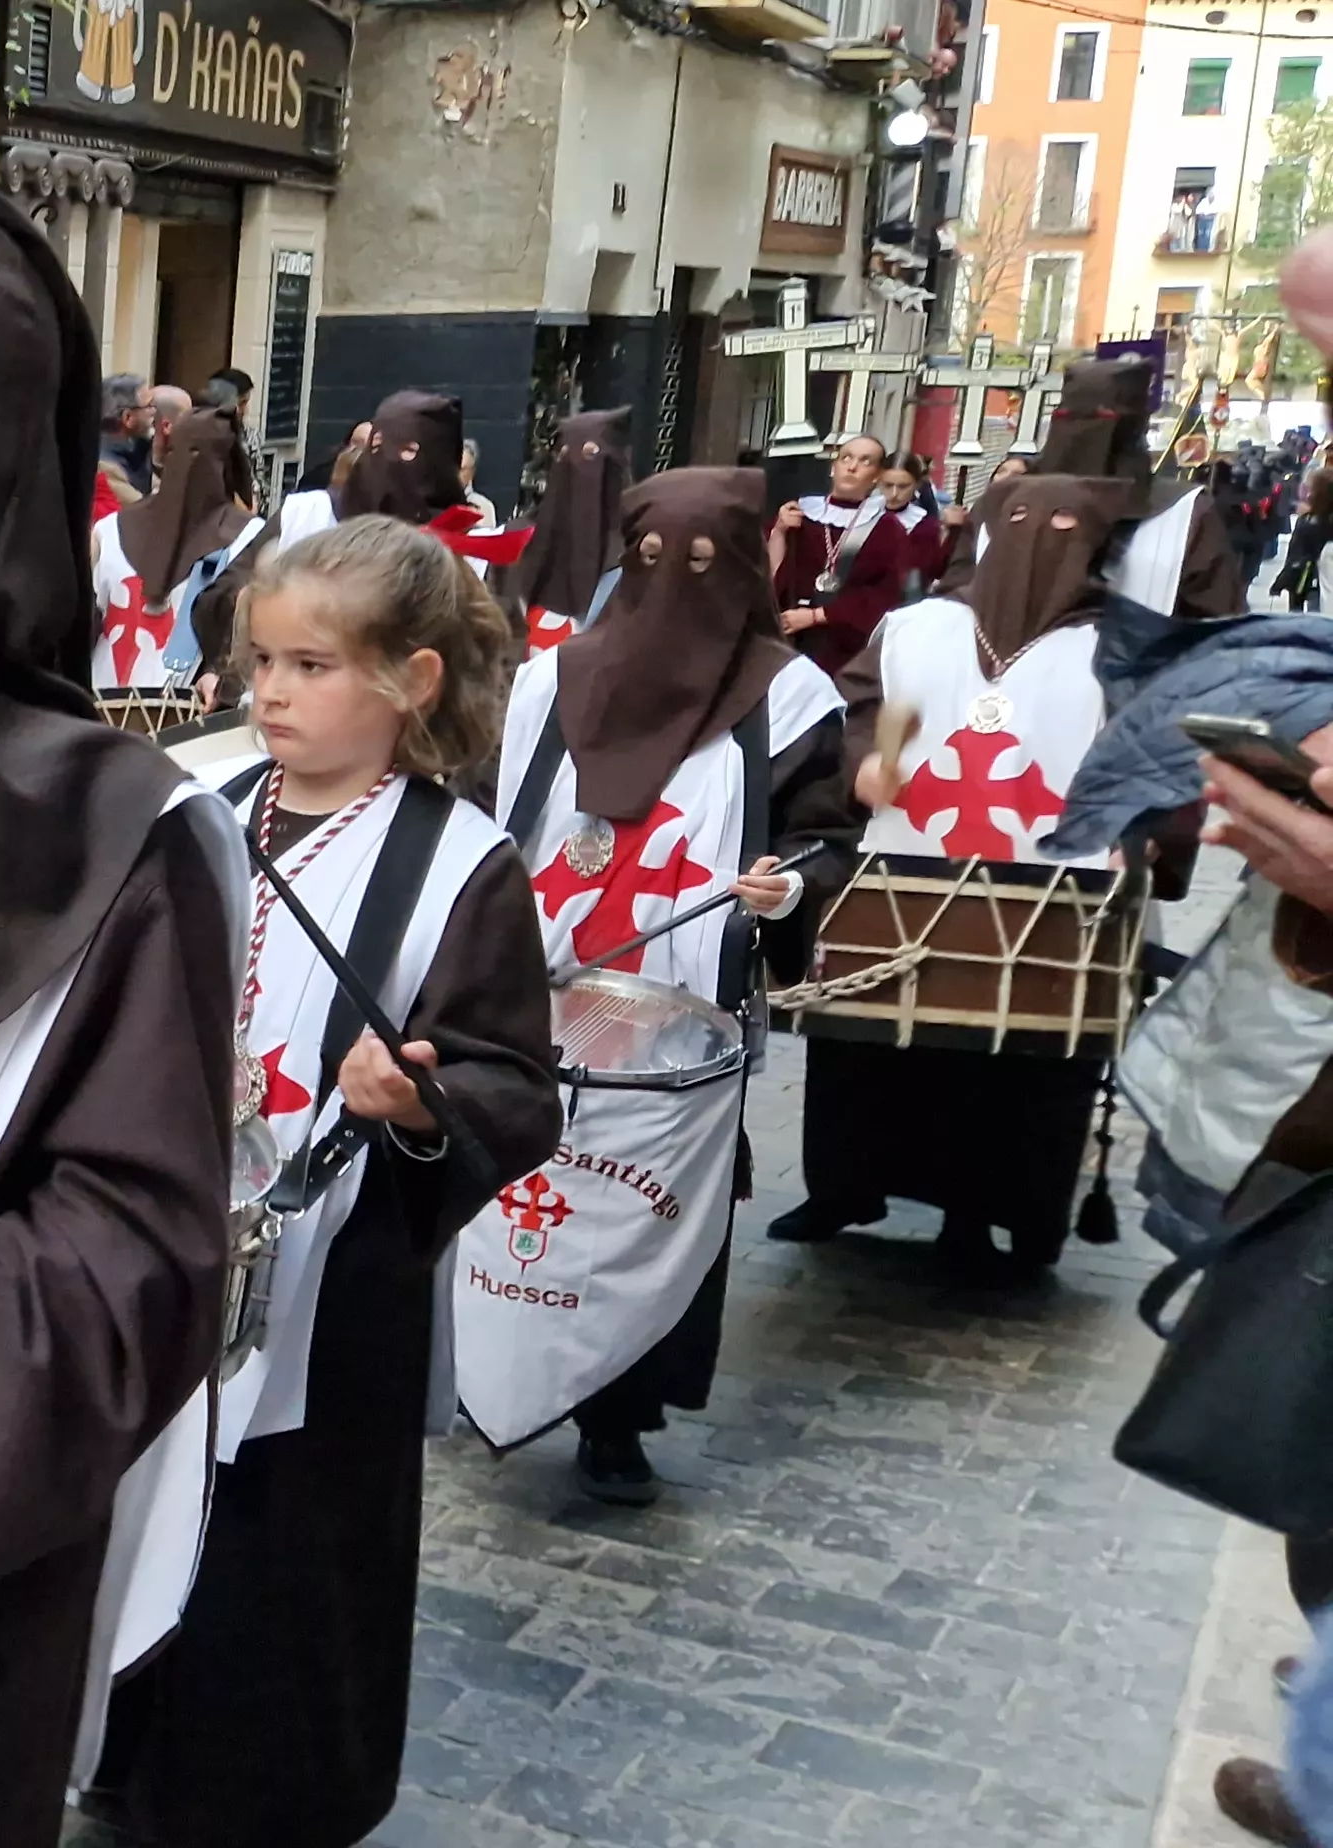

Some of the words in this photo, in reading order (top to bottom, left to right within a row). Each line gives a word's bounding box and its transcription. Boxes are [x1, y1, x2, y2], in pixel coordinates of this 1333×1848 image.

[153, 0, 305, 129] D'KAÑAS
[551, 1144, 679, 1220] Santiago
[469, 1264, 580, 1310] Huesca
